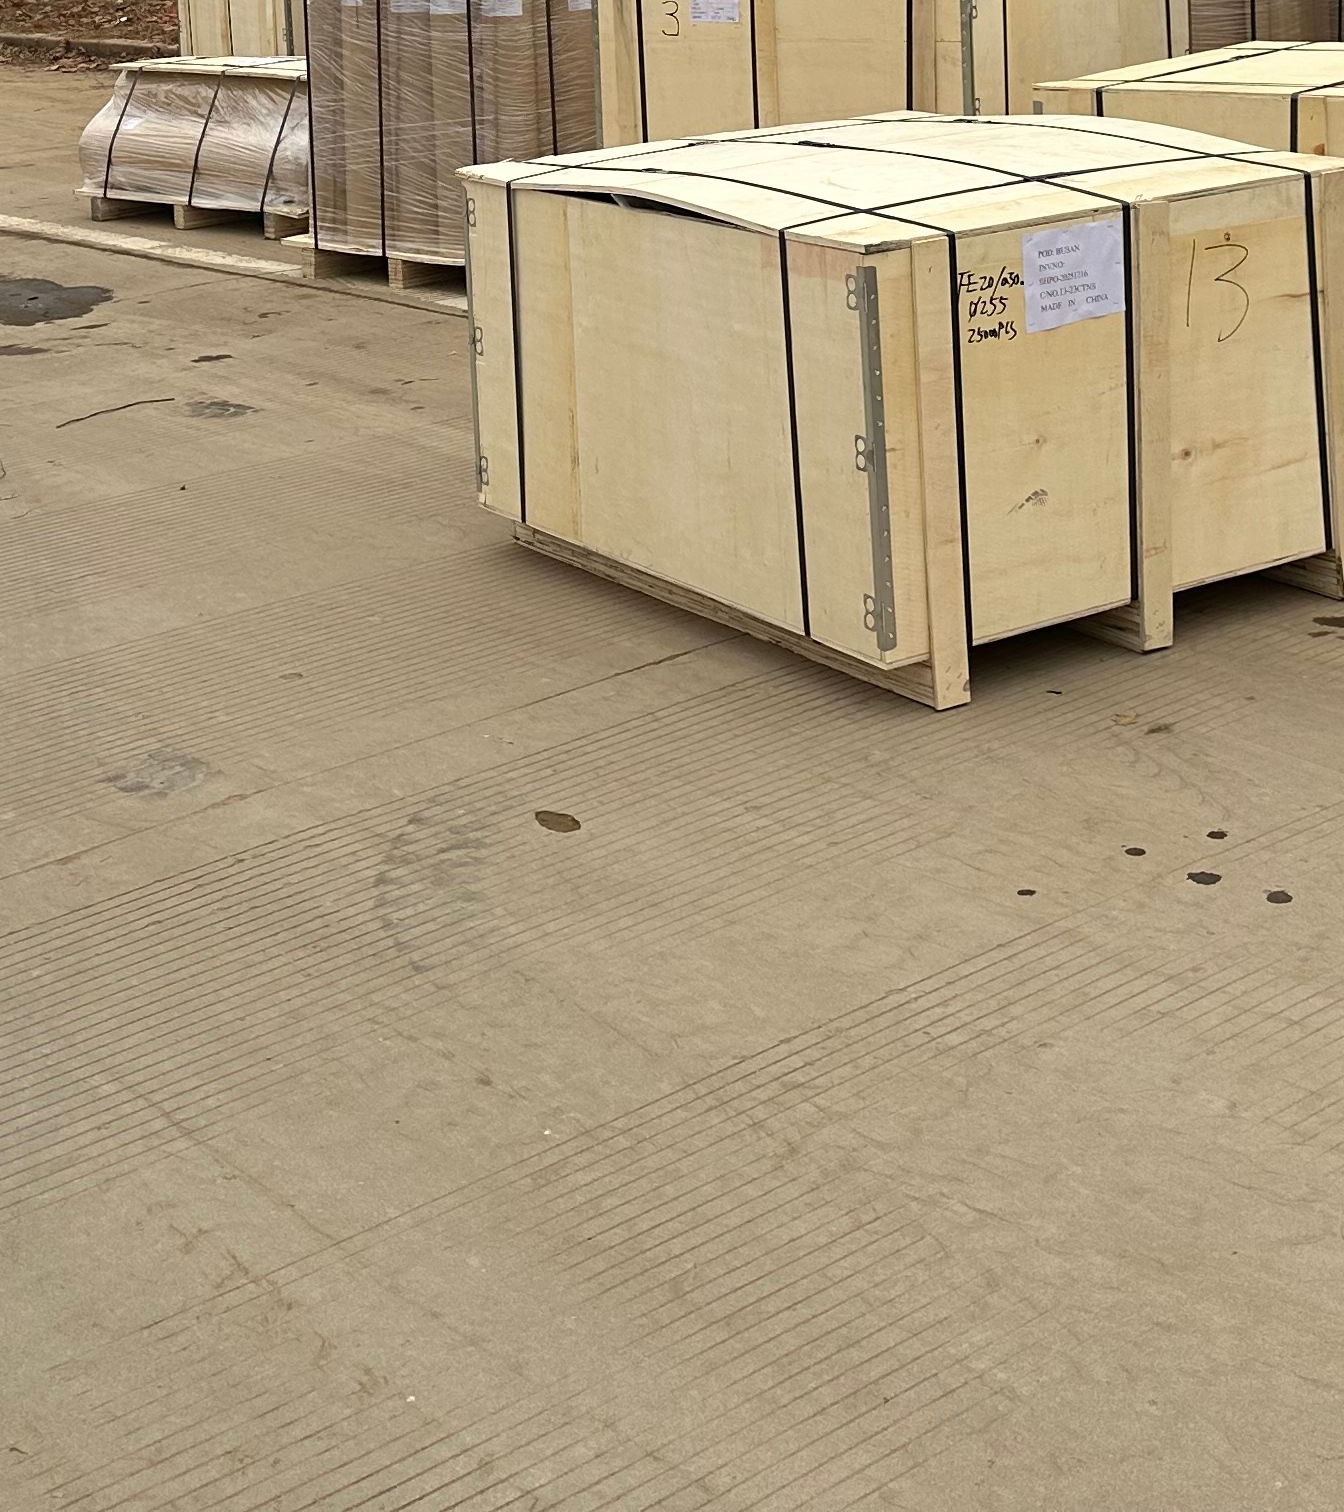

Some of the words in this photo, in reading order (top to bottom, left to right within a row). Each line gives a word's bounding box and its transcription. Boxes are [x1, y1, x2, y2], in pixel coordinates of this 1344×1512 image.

[661, 0, 680, 37] 3
[1055, 244, 1081, 256] BUSAN
[1040, 301, 1063, 313] MADE
[1067, 298, 1076, 307] IN
[1085, 293, 1109, 304] CHINA
[1186, 238, 1250, 343] 13
